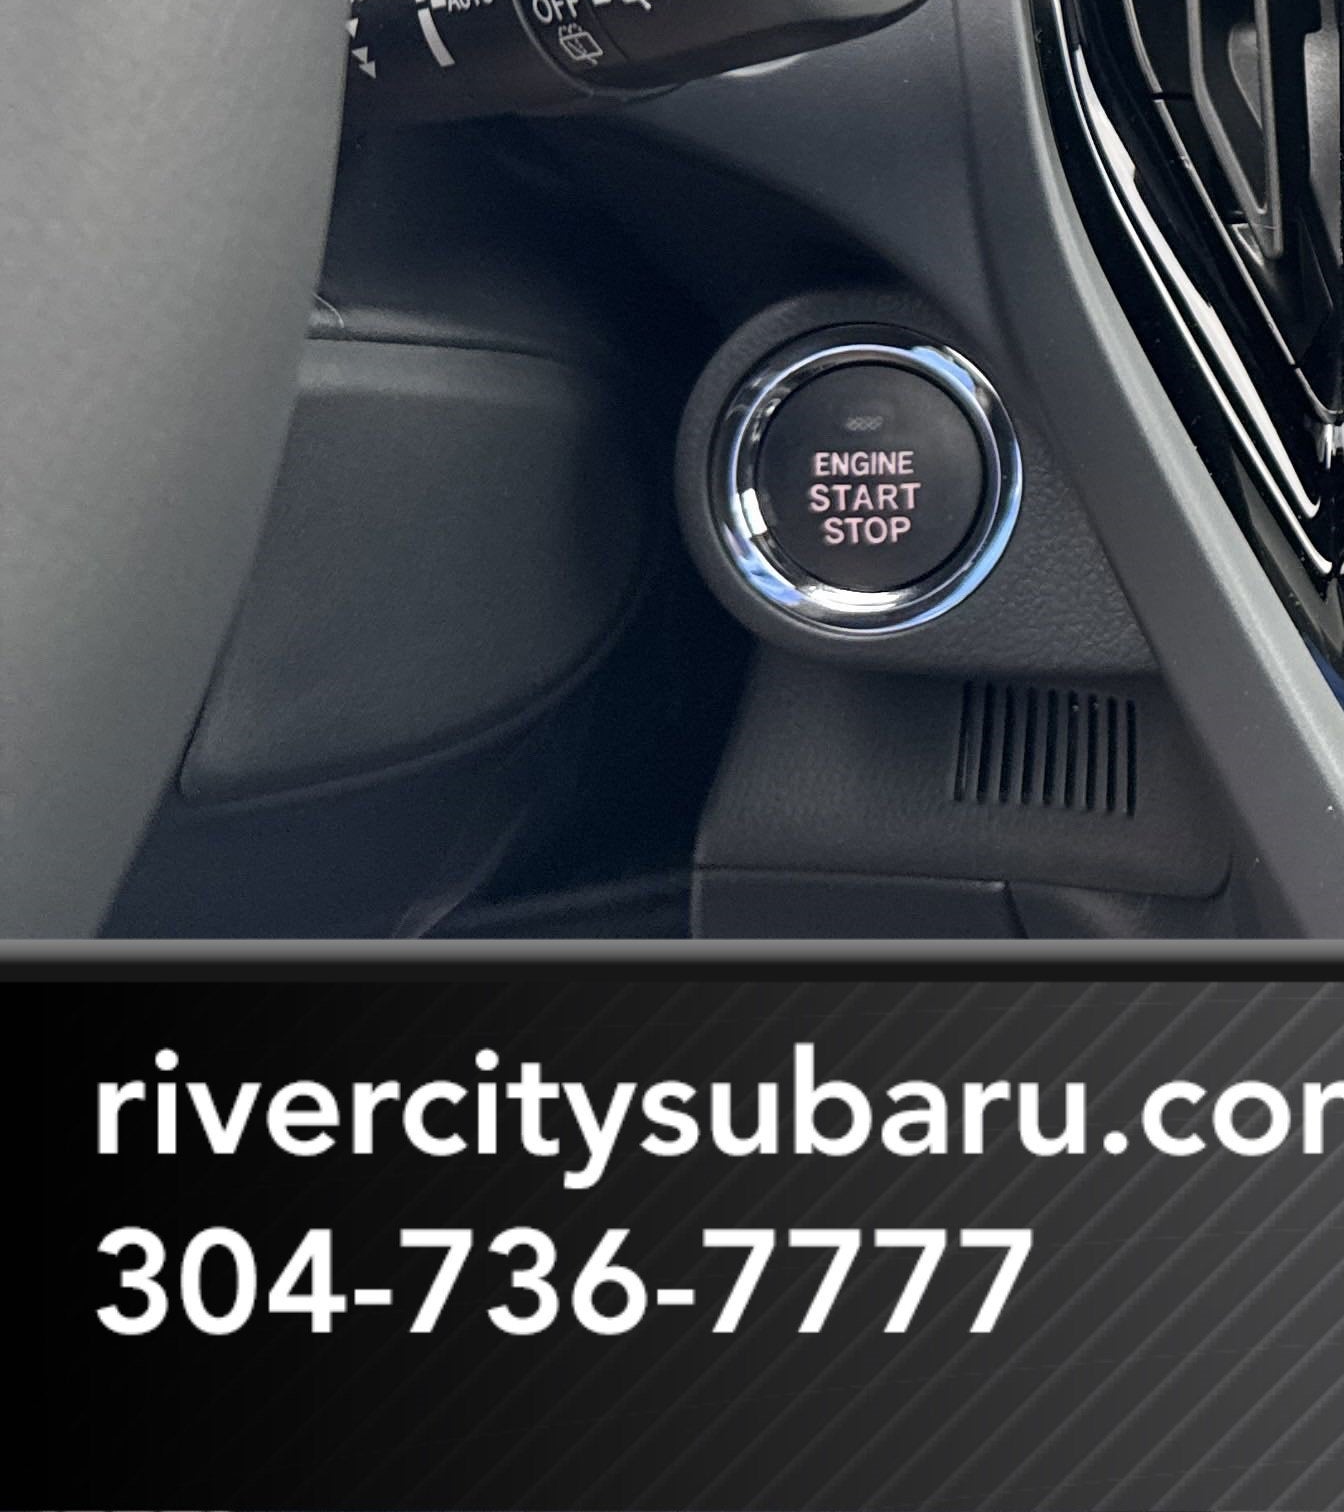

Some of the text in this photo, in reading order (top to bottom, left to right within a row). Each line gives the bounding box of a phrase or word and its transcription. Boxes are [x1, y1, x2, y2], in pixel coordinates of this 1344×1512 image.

[814, 451, 914, 476] ENGINE
[810, 483, 921, 512] START
[824, 516, 911, 545] STOP
